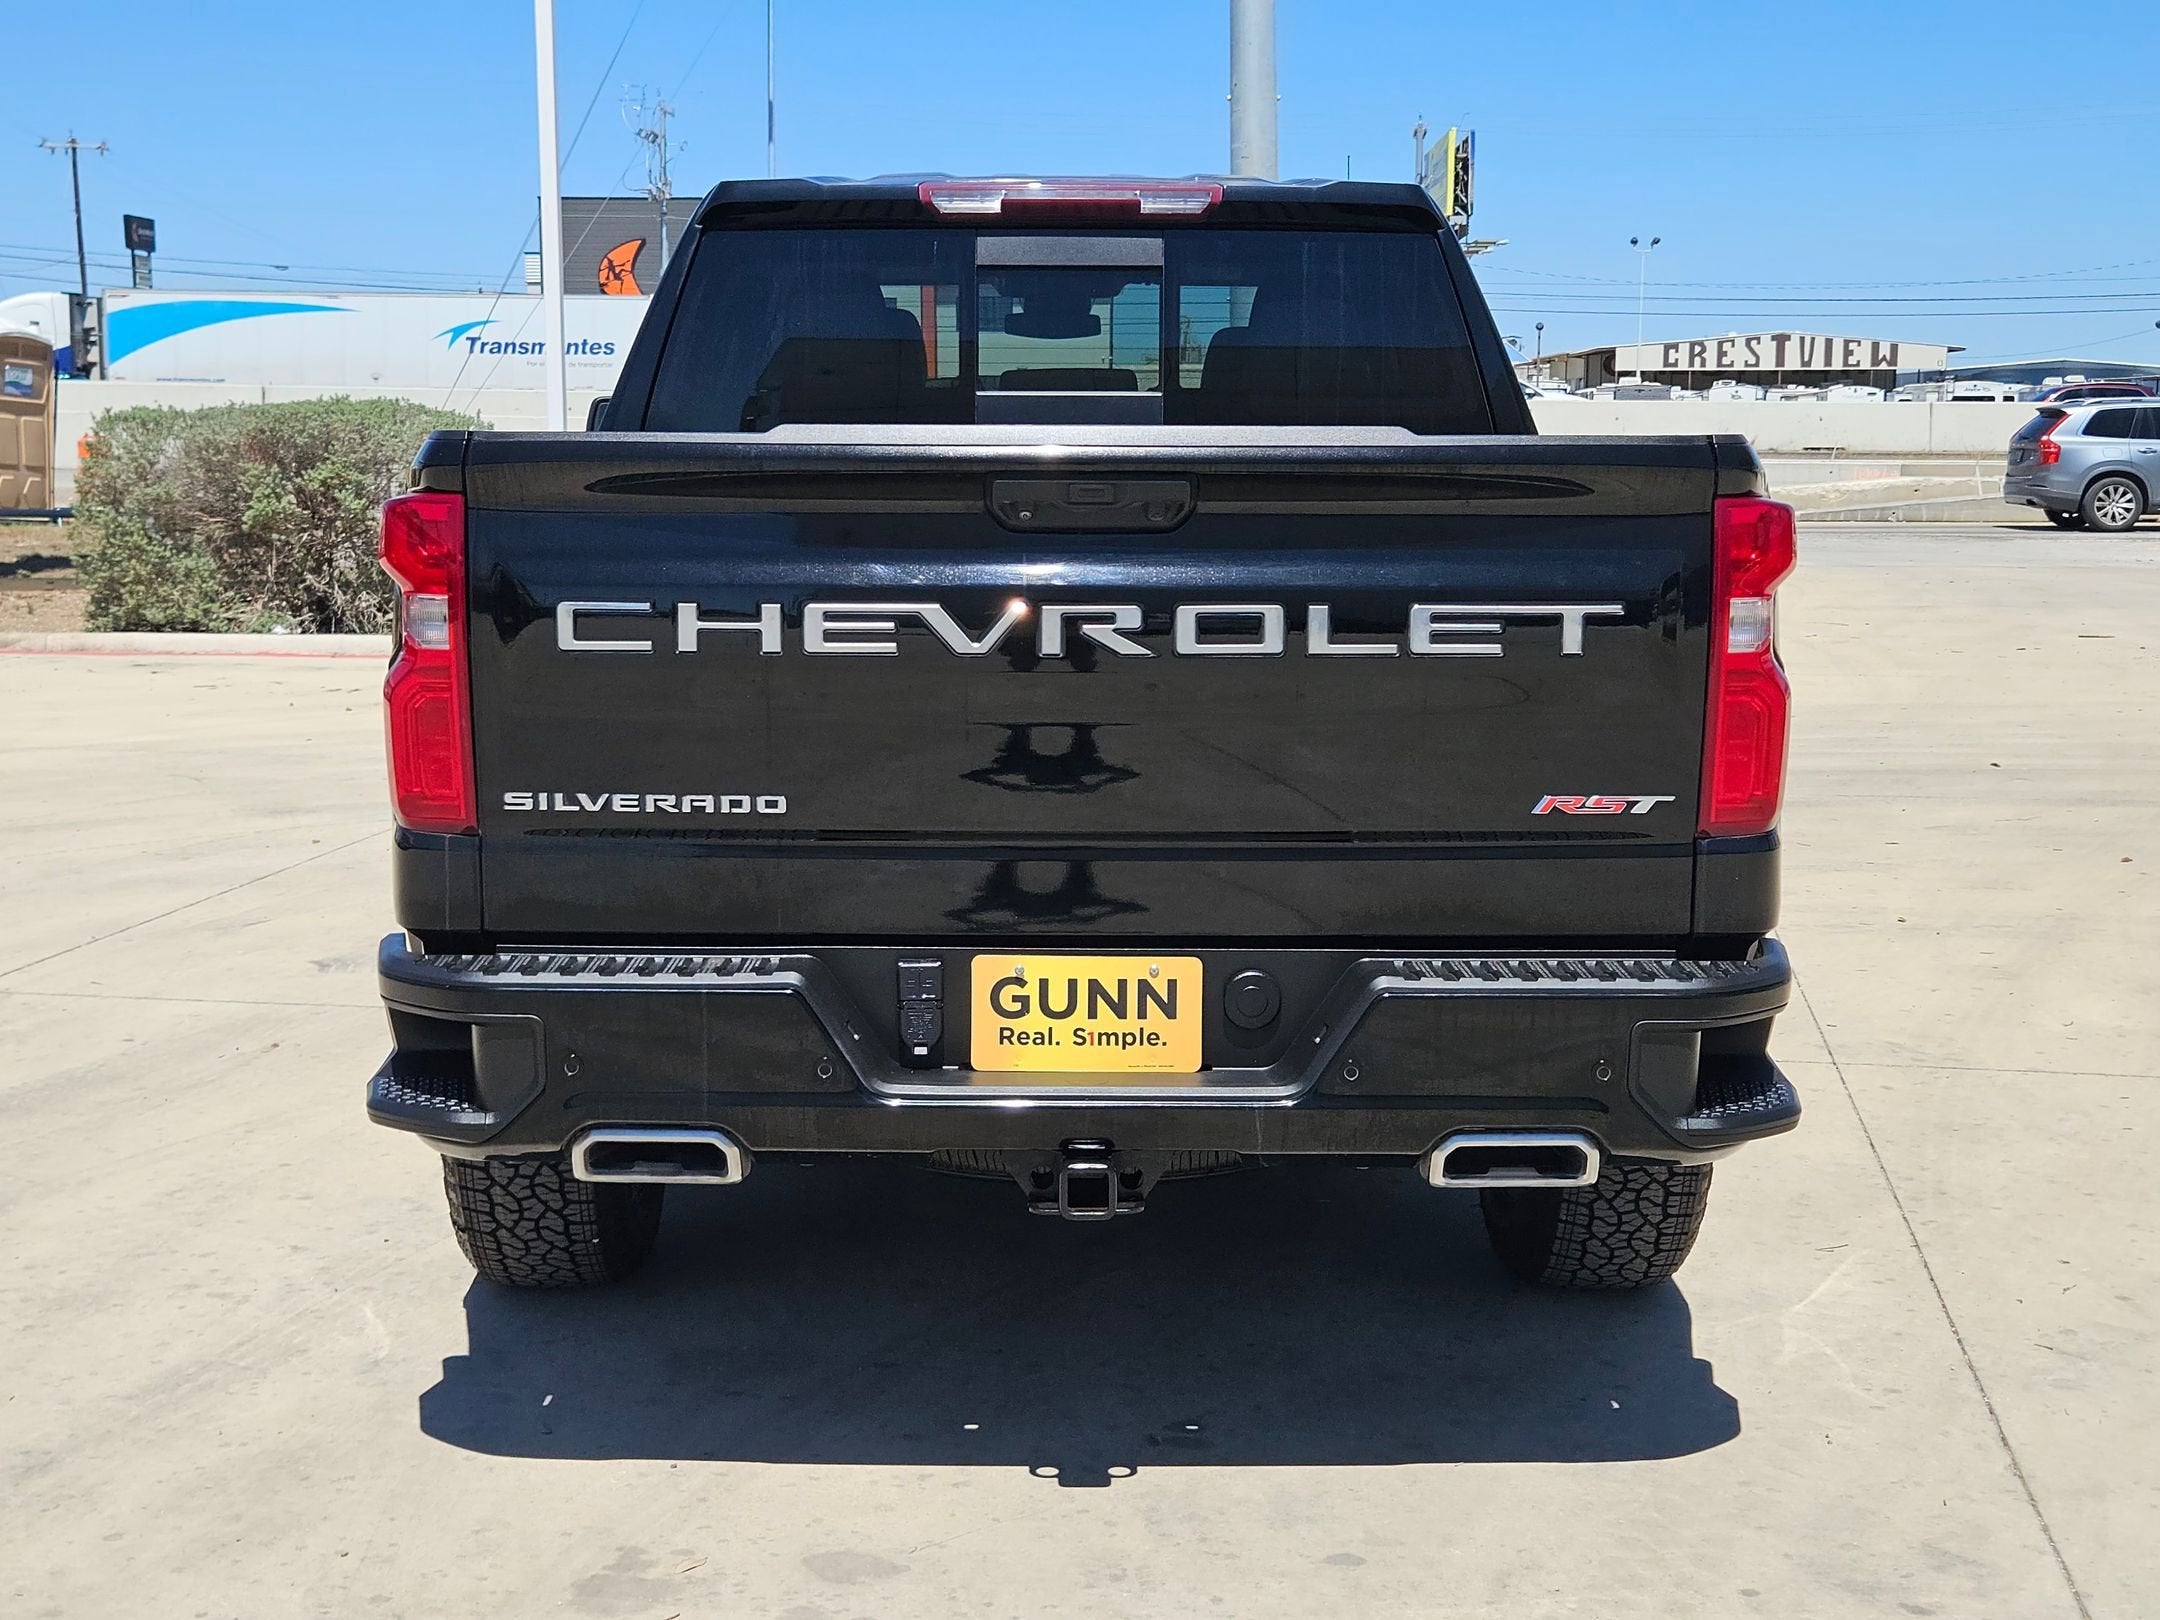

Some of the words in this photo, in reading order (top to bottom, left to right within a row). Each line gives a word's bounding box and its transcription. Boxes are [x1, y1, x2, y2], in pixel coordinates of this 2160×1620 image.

[465, 336, 616, 356] Transmntes
[1662, 334, 1899, 369] CRESTVIEW
[555, 600, 1626, 657] CHEVROLET
[503, 791, 788, 814] SILVERADO
[1530, 794, 1677, 815] RST
[989, 976, 1178, 1020] GUNN
[999, 1026, 1061, 1047] Real.
